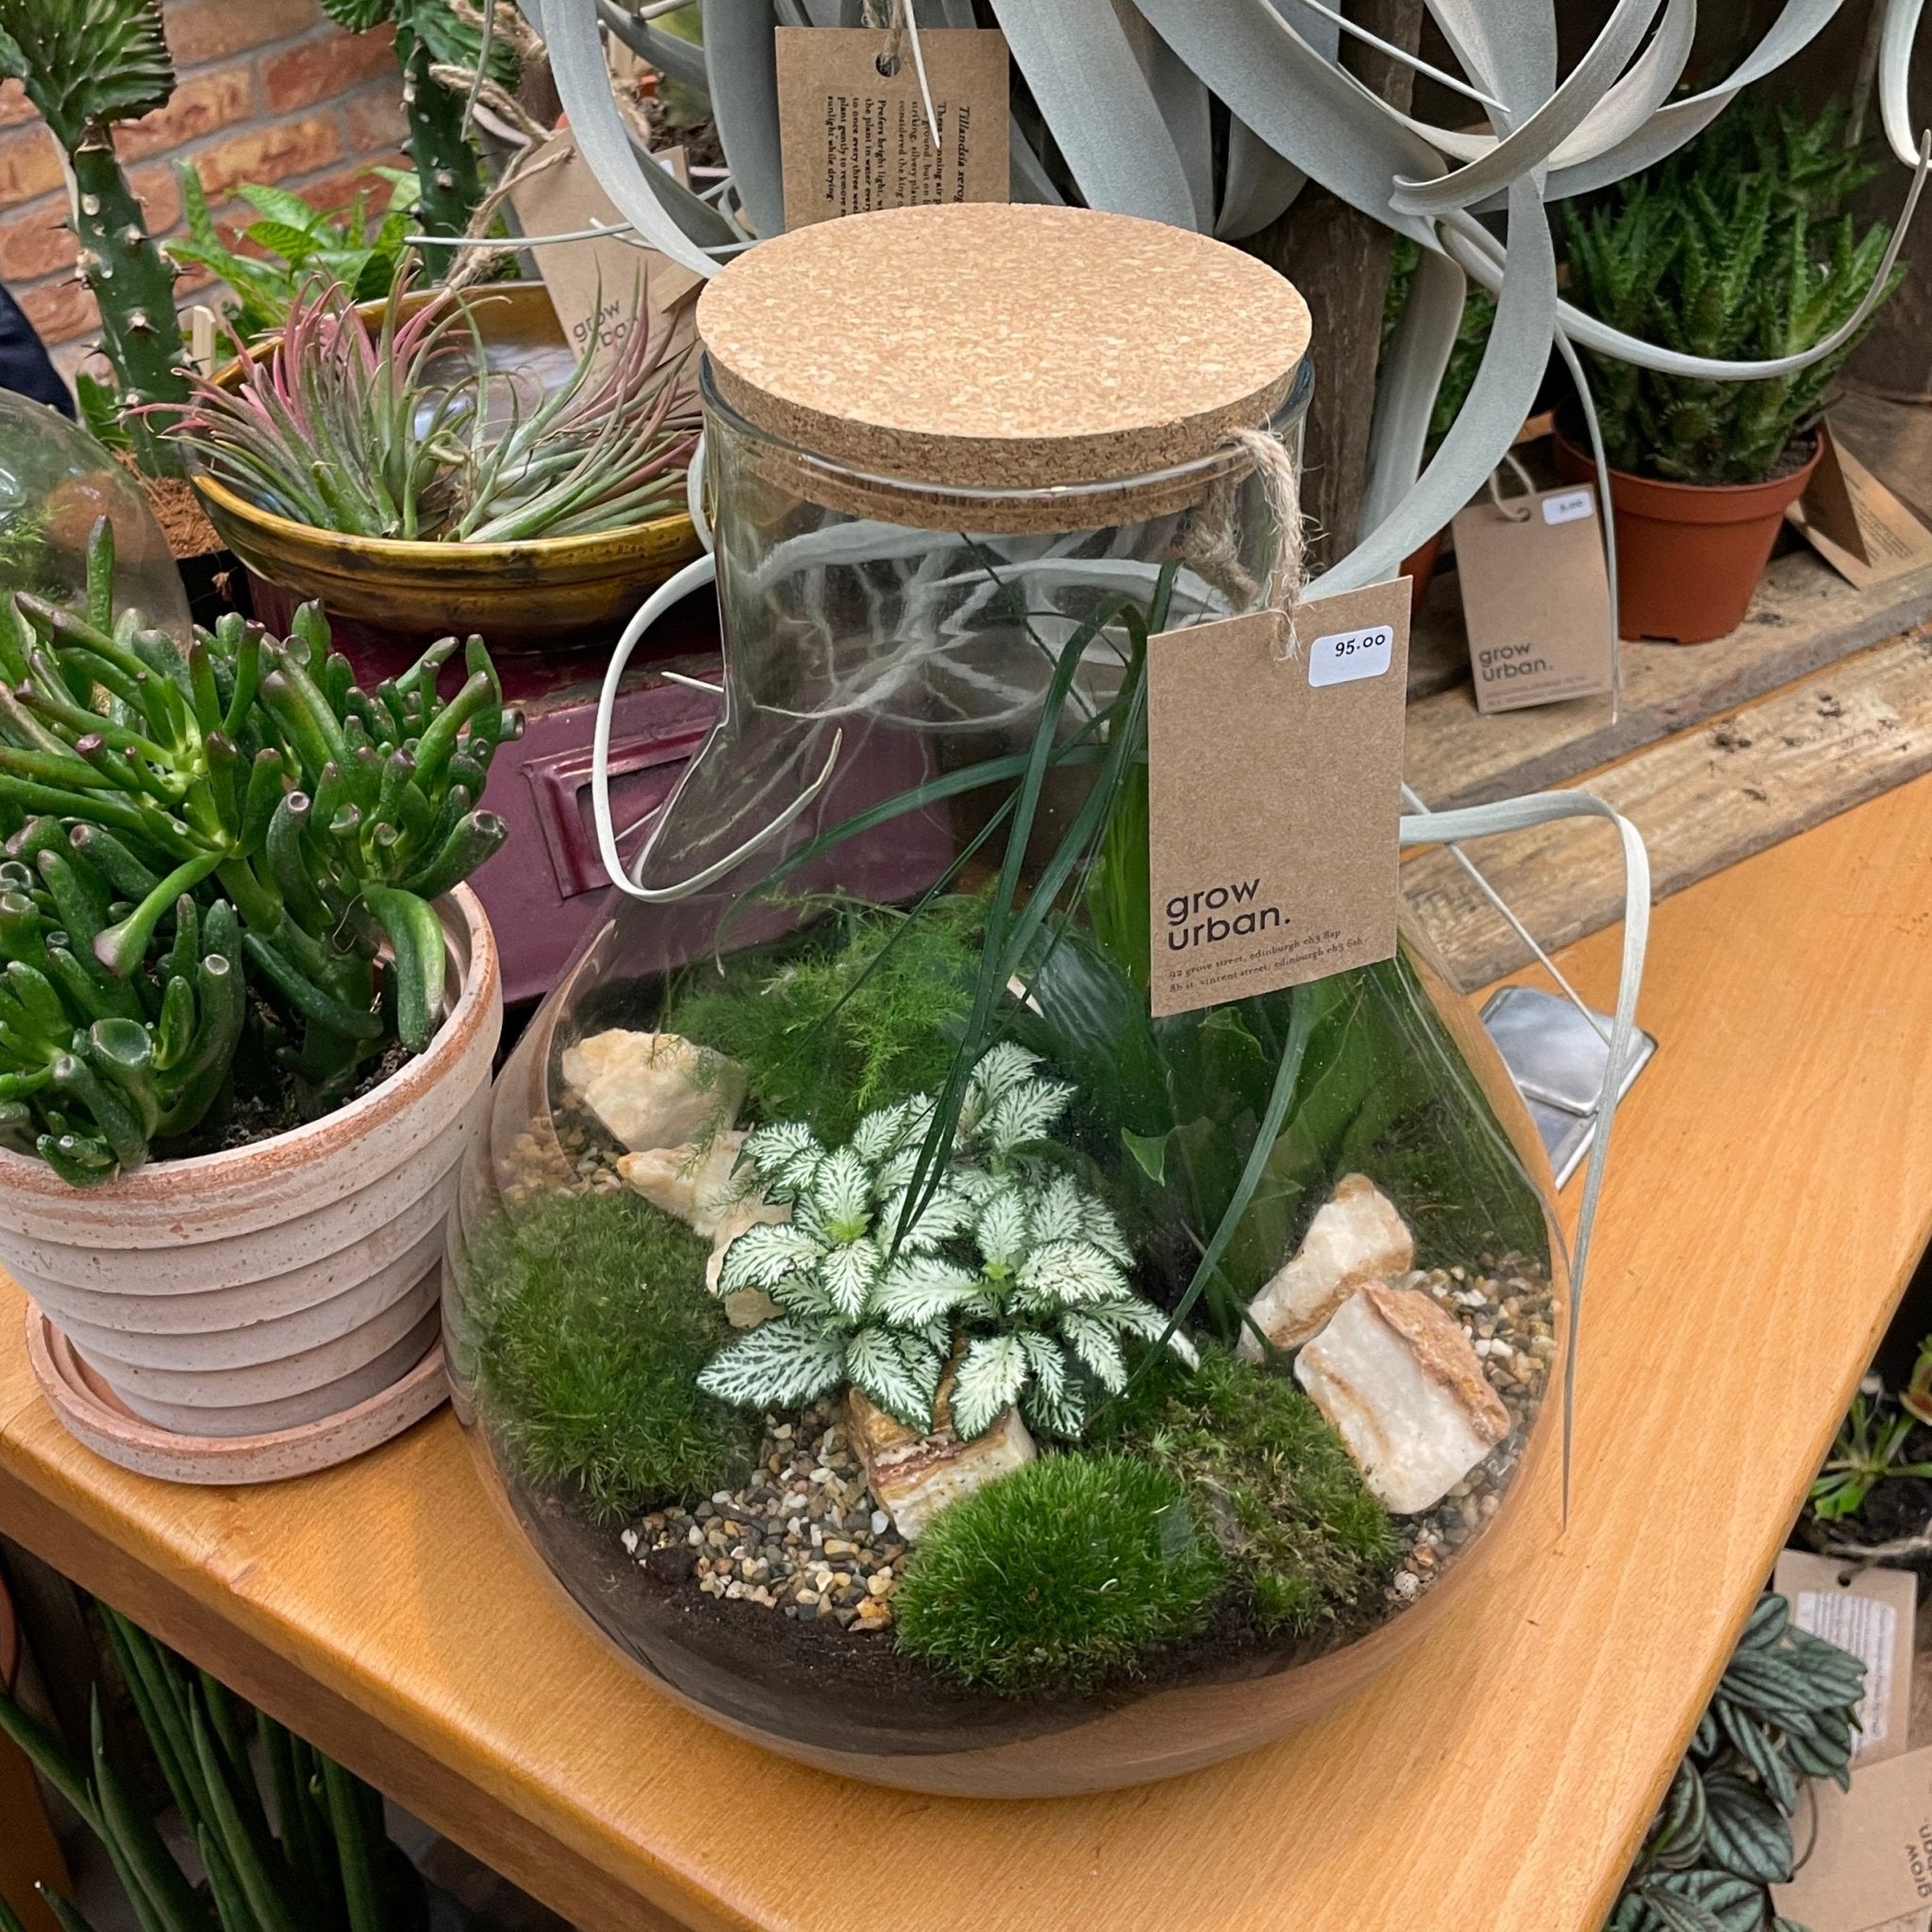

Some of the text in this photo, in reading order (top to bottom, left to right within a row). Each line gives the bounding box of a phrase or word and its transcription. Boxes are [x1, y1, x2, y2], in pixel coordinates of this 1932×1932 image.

[825, 95, 837, 137] sunlight
[837, 96, 850, 123] plant
[852, 97, 860, 108] to
[865, 98, 875, 114] the
[862, 117, 874, 143] plant
[877, 99, 887, 135] Prefers
[898, 100, 907, 155] considered
[837, 125, 850, 156] gently
[958, 105, 971, 166] Tillandsia
[827, 139, 837, 166] while
[840, 158, 848, 168] to
[850, 137, 859, 162] every
[865, 145, 873, 157] in
[874, 138, 887, 168] bright
[908, 146, 920, 176] silvery
[852, 164, 861, 191] three
[898, 158, 907, 174] the
[924, 163, 932, 180] but
[862, 188, 872, 212] every
[895, 176, 907, 198] king
[924, 182, 930, 196] on
[936, 183, 944, 195] air
[1335, 634, 1386, 658] 95.00
[1478, 641, 1532, 668] grow
[1165, 877, 1261, 926] grow
[1168, 906, 1291, 951] urban.
[1169, 969, 1183, 980] 92
[1185, 963, 1212, 978] grove
[1216, 955, 1247, 968] street,
[1249, 940, 1301, 960] edinburgh
[1274, 947, 1324, 969] edinburgh
[1904, 1843, 1932, 1898] grow
